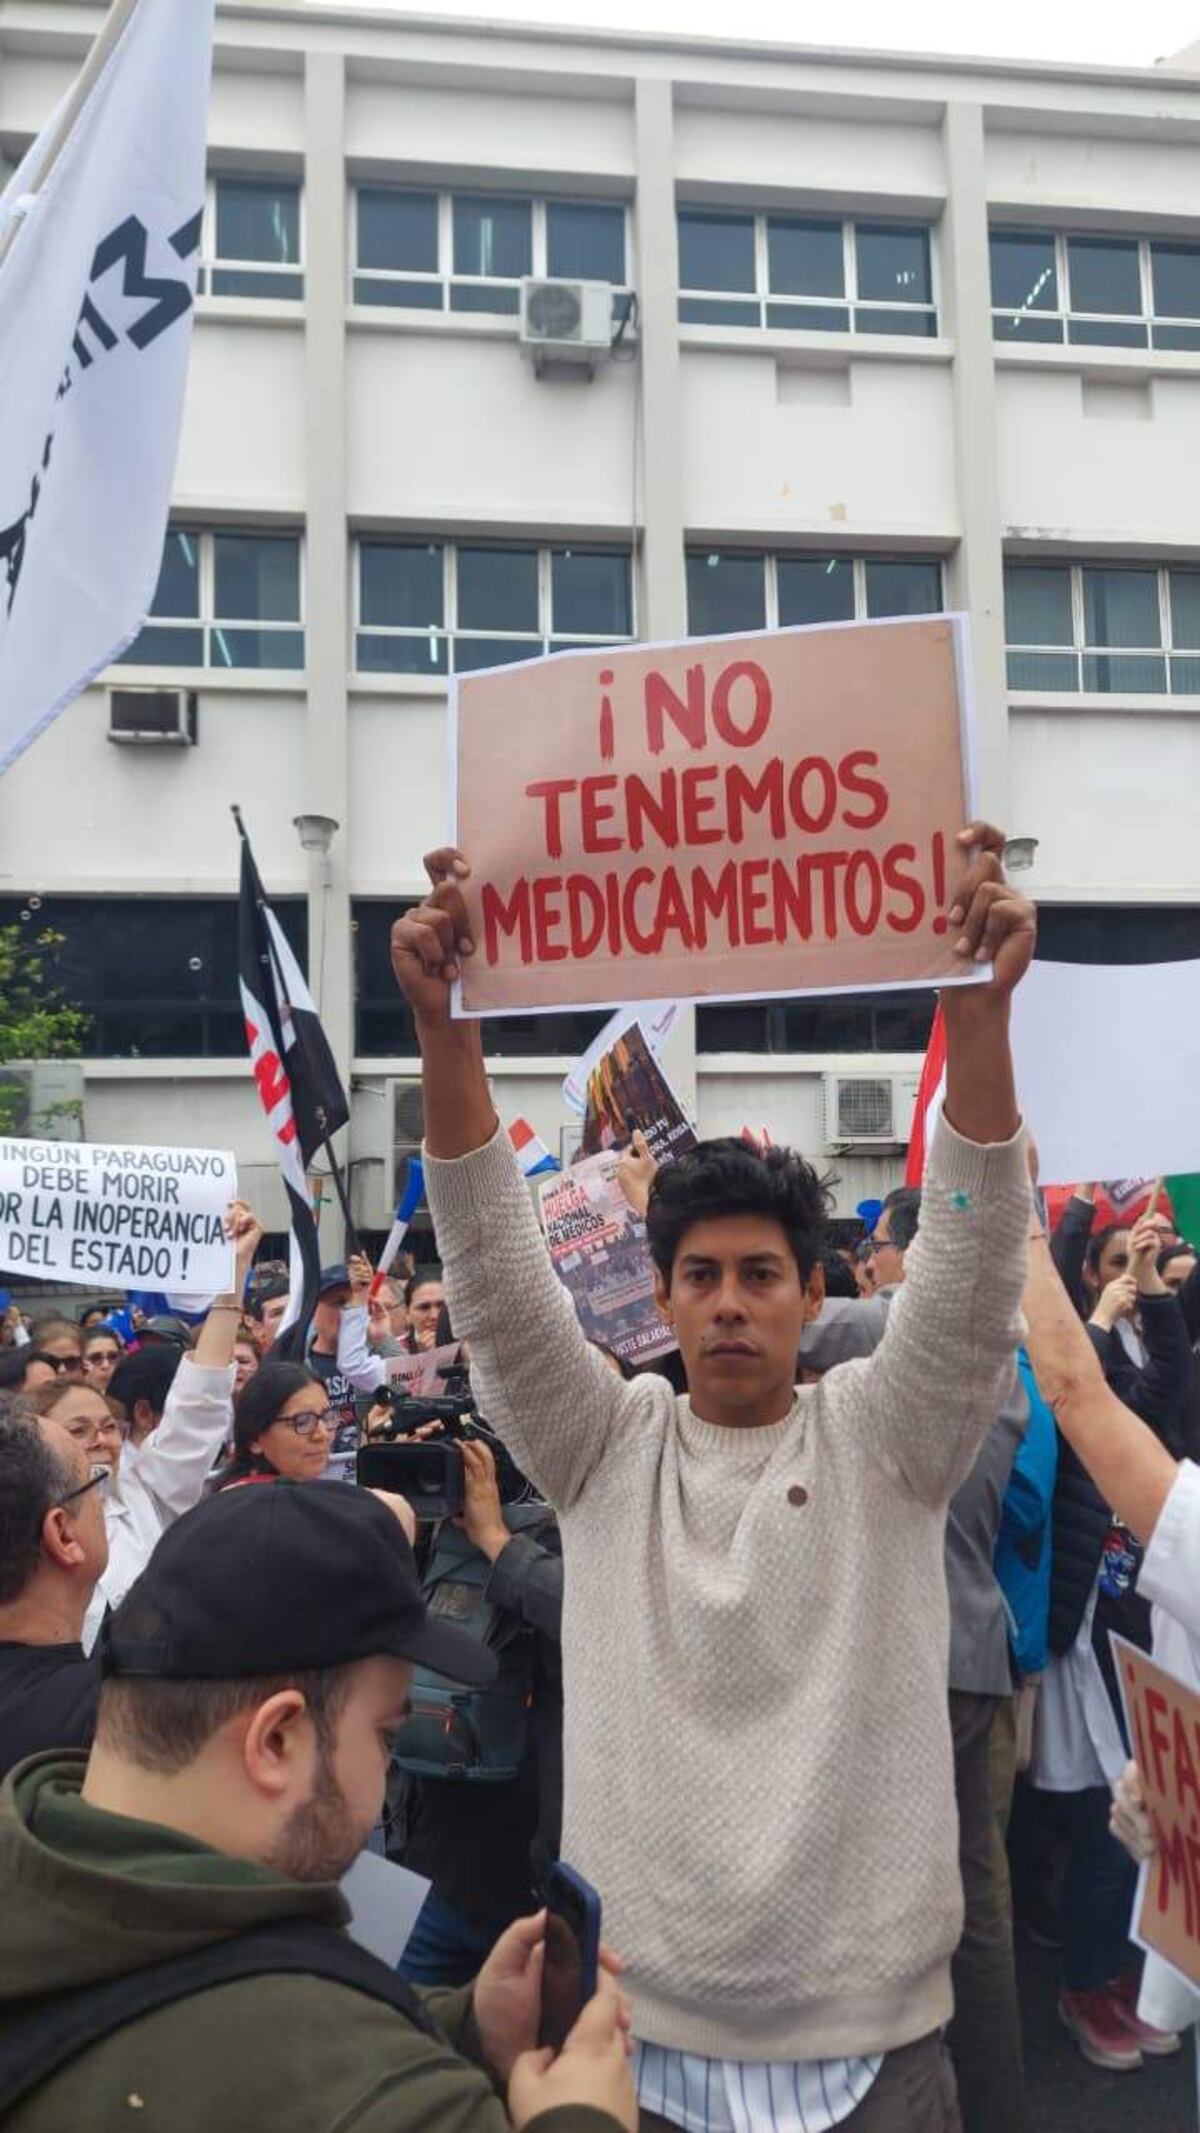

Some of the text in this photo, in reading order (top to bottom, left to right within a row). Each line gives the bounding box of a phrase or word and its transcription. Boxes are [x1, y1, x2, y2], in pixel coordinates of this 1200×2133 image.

[525, 750, 889, 860] TENEMOS
[480, 831, 950, 966] MEDICAMENTOS!
[22, 1165, 180, 1204] DEBE MORIR
[93, 1150, 225, 1177] PARAGUAYO
[32, 1194, 63, 1230] LA
[73, 1200, 226, 1245] INOPERANCIA
[8, 1231, 57, 1266] DEL
